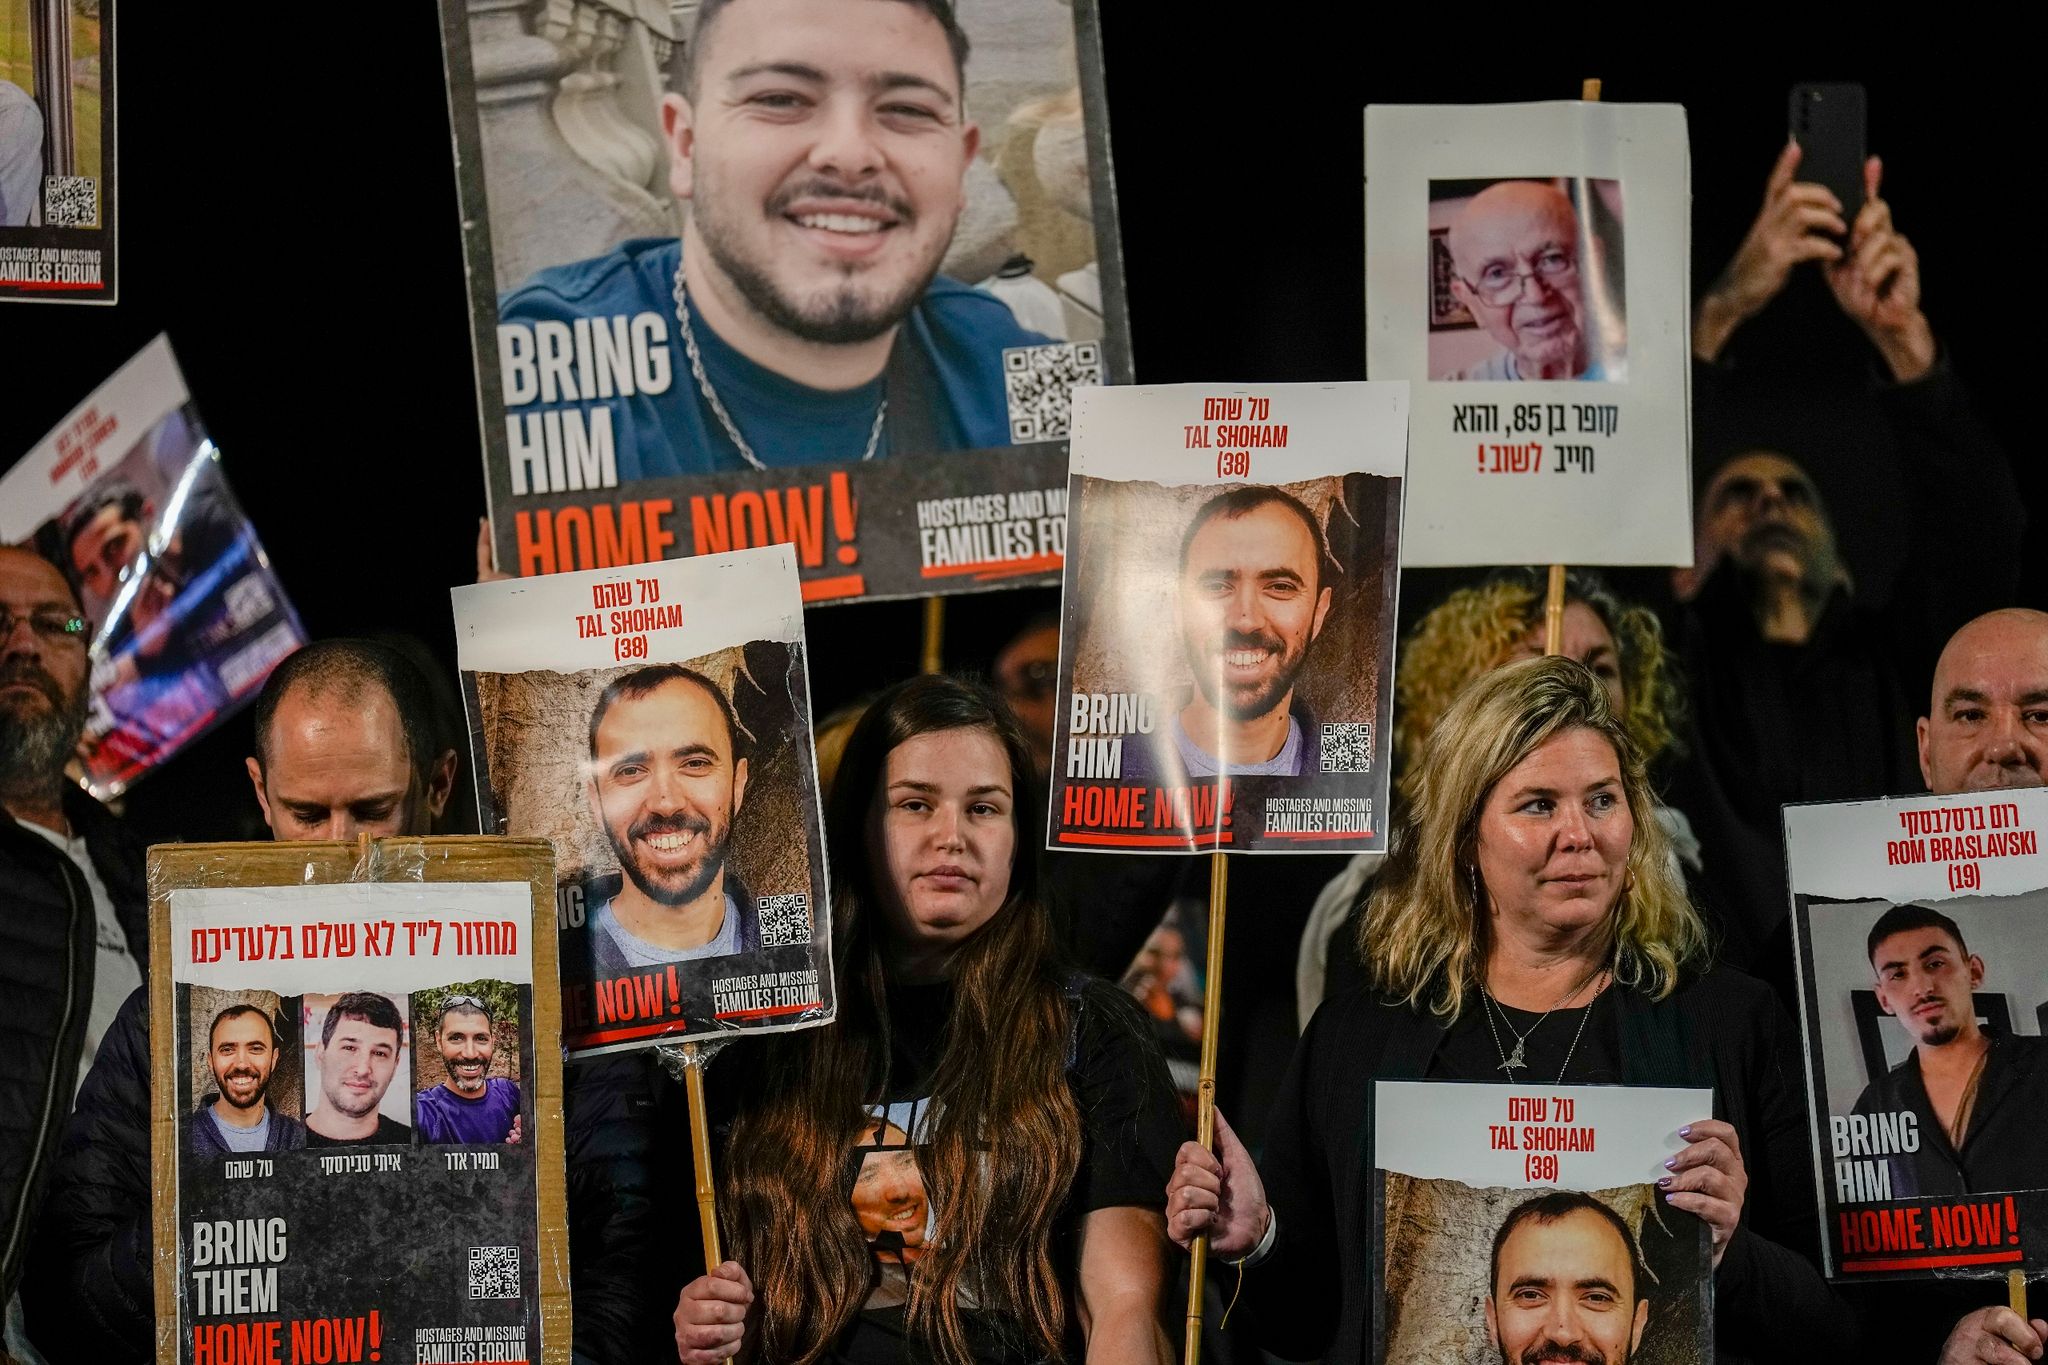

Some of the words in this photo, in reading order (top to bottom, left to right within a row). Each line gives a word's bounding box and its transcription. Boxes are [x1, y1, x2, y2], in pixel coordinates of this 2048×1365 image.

[0, 247, 40, 262] OSTAGES
[41, 248, 60, 263] AND
[60, 249, 101, 264] MISSING
[0, 261, 52, 283] AMILIES
[54, 263, 101, 284] FORUM
[497, 312, 672, 406] BRING
[1203, 398, 1243, 421] שהם
[1247, 397, 1270, 421] טל
[1453, 404, 1498, 432] והוא
[1505, 404, 1541, 438] 85,
[1546, 404, 1566, 436] בן
[1571, 404, 1618, 437] קופר
[505, 406, 618, 495] HIM
[1184, 425, 1212, 449] TAL
[1216, 425, 1288, 448] SHOHAM
[1217, 451, 1250, 478] (38)
[1553, 444, 1595, 473] חייב
[917, 494, 1007, 528] HOSTAGES
[1008, 490, 1044, 520] AND
[515, 499, 675, 577] HOME
[690, 471, 858, 568] NOW!
[920, 520, 1034, 567] FAMILIES
[592, 581, 632, 609] שהם
[636, 578, 660, 604] טל
[576, 613, 607, 638] TAL
[610, 604, 683, 635] SHOHAM
[614, 634, 648, 661] (38)
[1066, 738, 1122, 779] HIM
[1063, 786, 1147, 828] HOME
[1153, 778, 1236, 828] NOW!
[1265, 798, 1311, 812] HOSTAGES
[1313, 798, 1331, 812] AND
[1332, 798, 1372, 812] MISSING
[1989, 803, 2019, 829] רום
[1265, 812, 1323, 833] FAMILIES
[1326, 812, 1372, 832] FORUM
[1899, 806, 1986, 838] ברסלבסקי
[1887, 839, 1926, 866] ROM
[1930, 830, 2038, 862] BRASLAVSKI
[1948, 862, 1981, 892] (19)
[191, 924, 294, 963] בלעדיכם
[302, 922, 355, 958] שלם
[363, 920, 395, 956] לא
[450, 921, 517, 955] מחזור
[594, 965, 682, 1025] NOW!
[712, 975, 758, 994] HOSTAGES
[760, 973, 777, 988] AND
[779, 969, 818, 986] MISSING
[713, 988, 772, 1014] FAMILIES
[774, 984, 820, 1008] FORUM
[1508, 1097, 1547, 1122] שהם
[1552, 1096, 1575, 1123] טל
[1489, 1125, 1518, 1150] TAL
[1522, 1126, 1595, 1152] SHOHAM
[1830, 1110, 1920, 1158] BRING
[225, 1160, 253, 1179] שהם
[257, 1159, 273, 1178] טל
[320, 1154, 371, 1176] סבירסקי
[374, 1153, 402, 1172] איתי
[444, 1152, 467, 1171] אדר
[470, 1152, 499, 1170] תמיר
[1525, 1154, 1559, 1183] (38)
[1834, 1159, 1892, 1204] HIM
[1839, 1207, 1925, 1254] HOME
[1930, 1196, 2019, 1249] NOW!
[193, 1217, 288, 1266] BRING
[192, 1268, 279, 1316] THEM
[194, 1321, 282, 1365] HOME
[291, 1309, 385, 1365] NOW!
[415, 1327, 463, 1343] HOSTAGES
[464, 1327, 483, 1342] AND
[484, 1325, 526, 1341] MISSING
[416, 1342, 476, 1365] FAMILIES
[478, 1341, 527, 1363] FORUM
